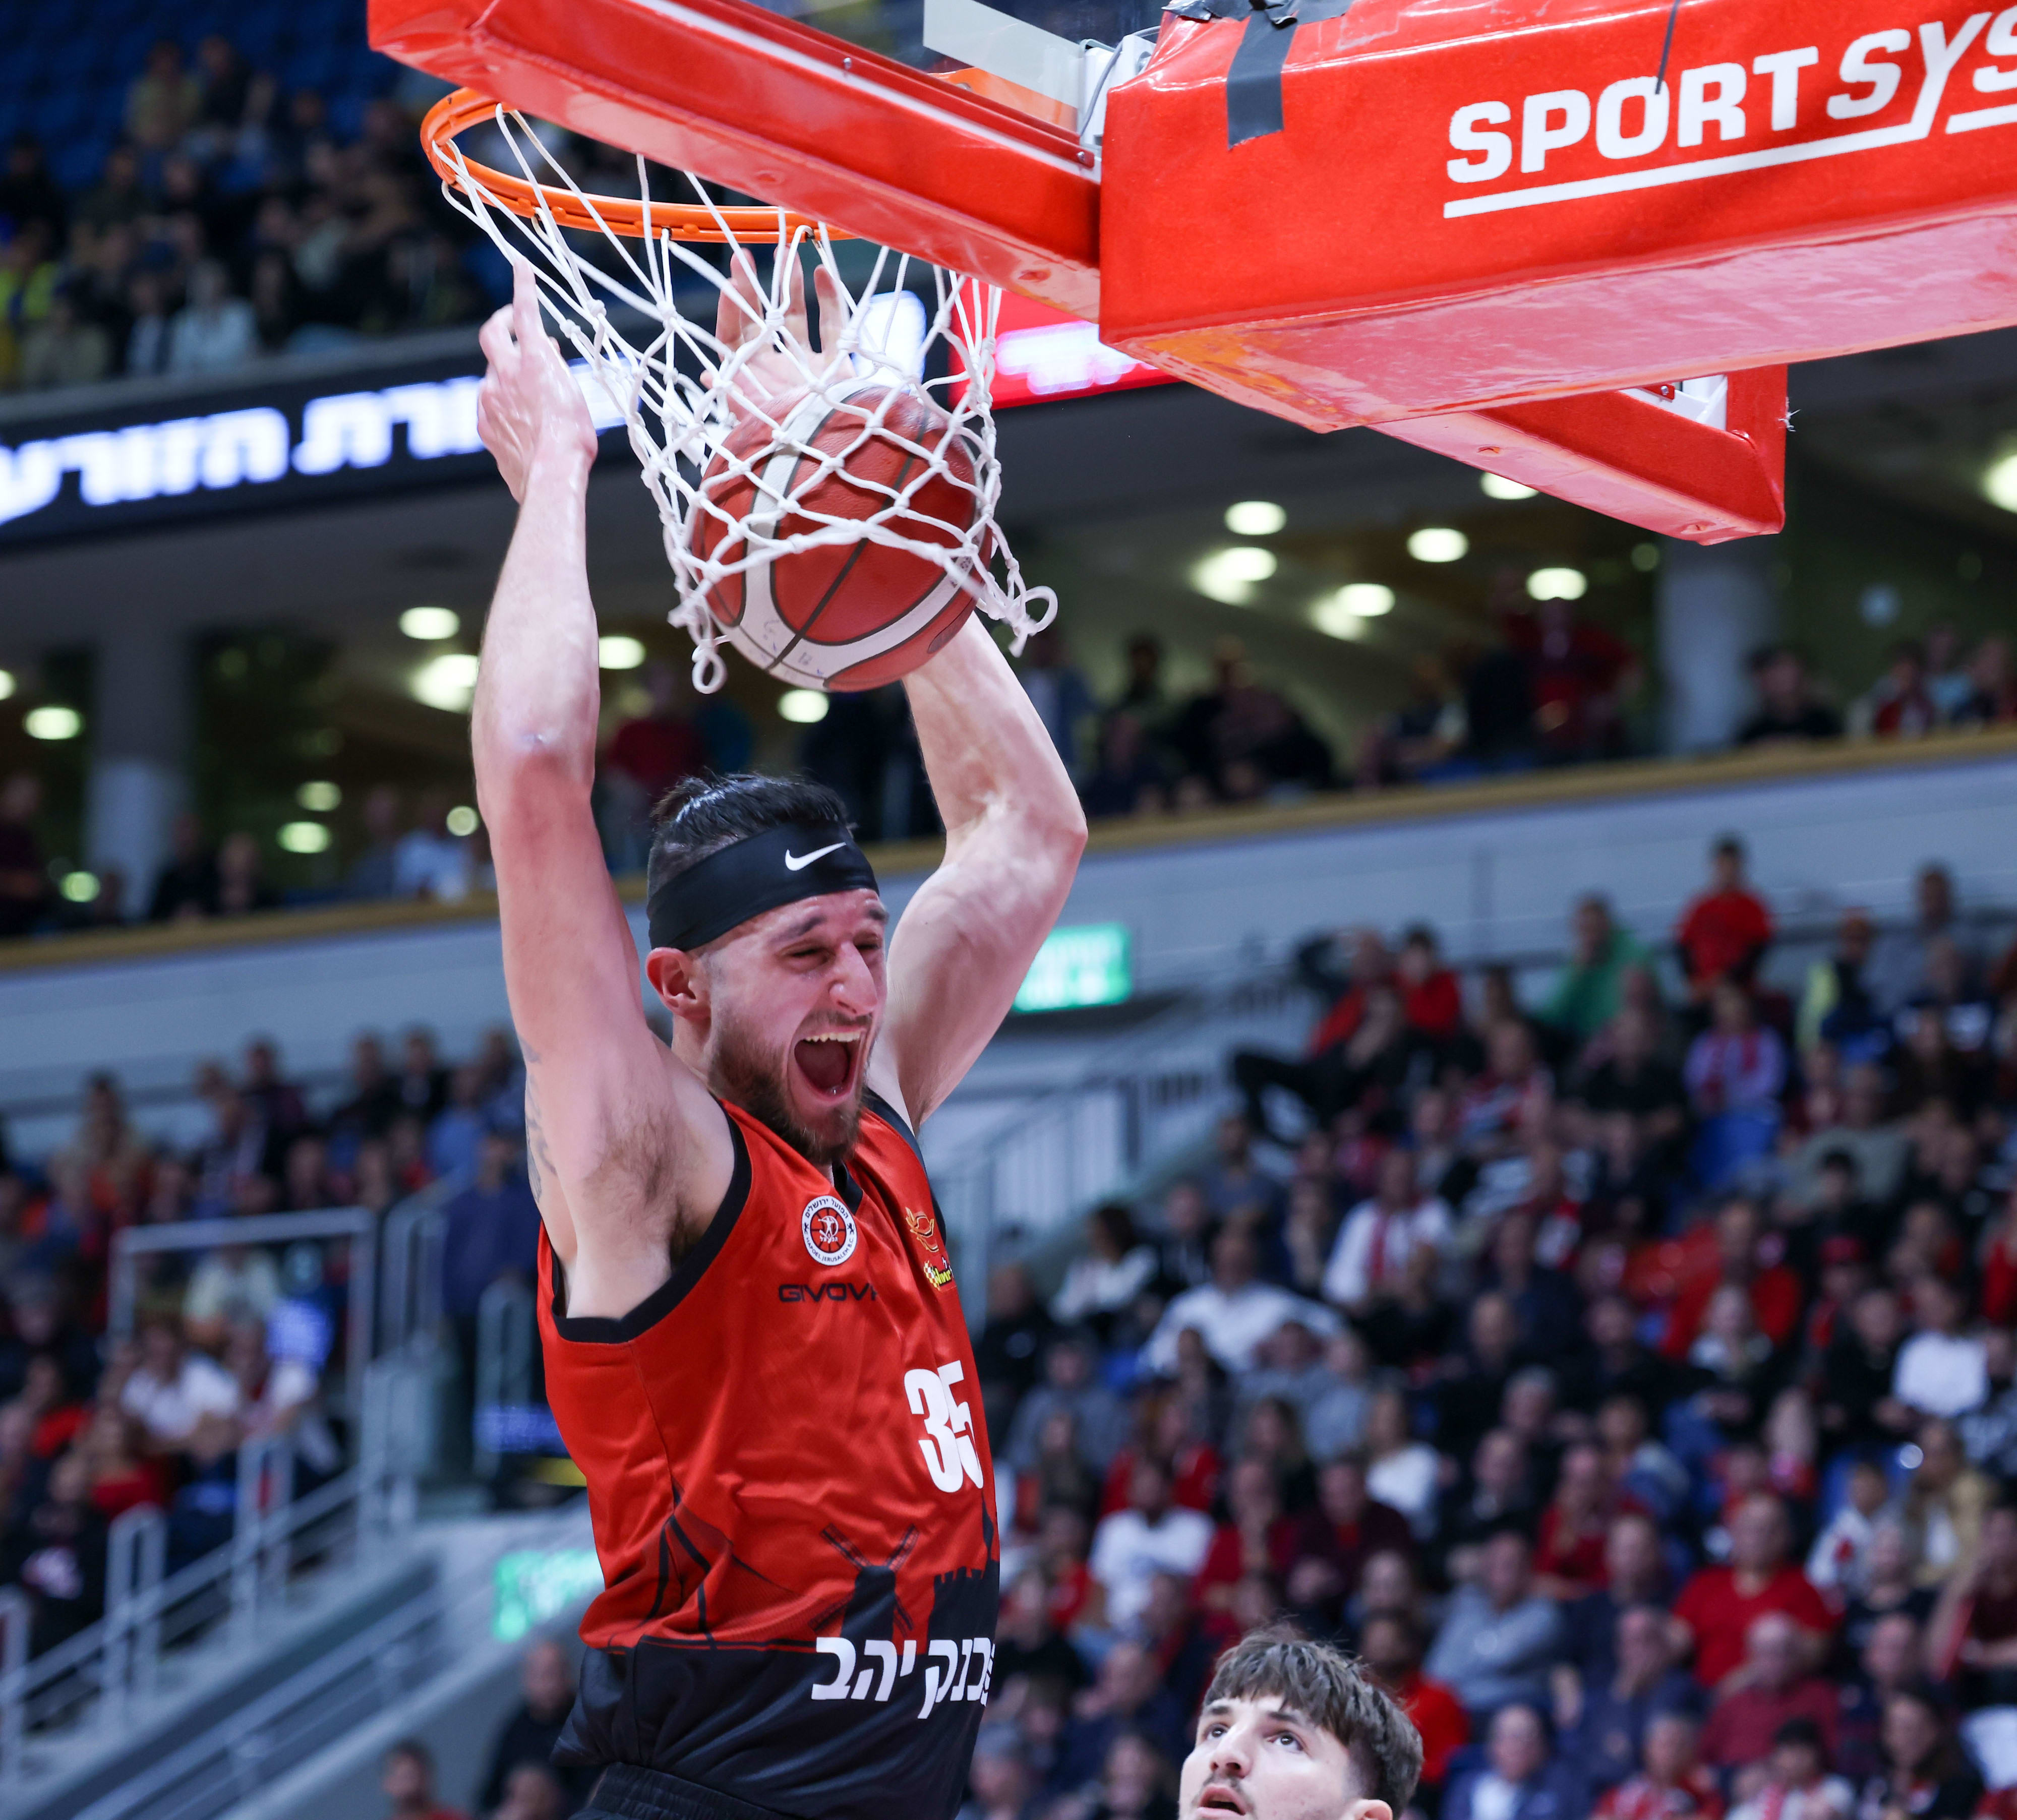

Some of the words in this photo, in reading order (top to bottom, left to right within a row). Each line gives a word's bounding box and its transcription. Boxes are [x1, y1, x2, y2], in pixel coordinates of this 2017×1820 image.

[805, 1198, 828, 1219] ירושלים
[832, 1198, 849, 1219] הפועל
[806, 1237, 821, 1259] HAPOEL
[822, 1247, 850, 1262] JERUSALEM
[904, 1359, 984, 1493] 35
[811, 1636, 917, 1702] יהב
[917, 1637, 992, 1720] בנק
